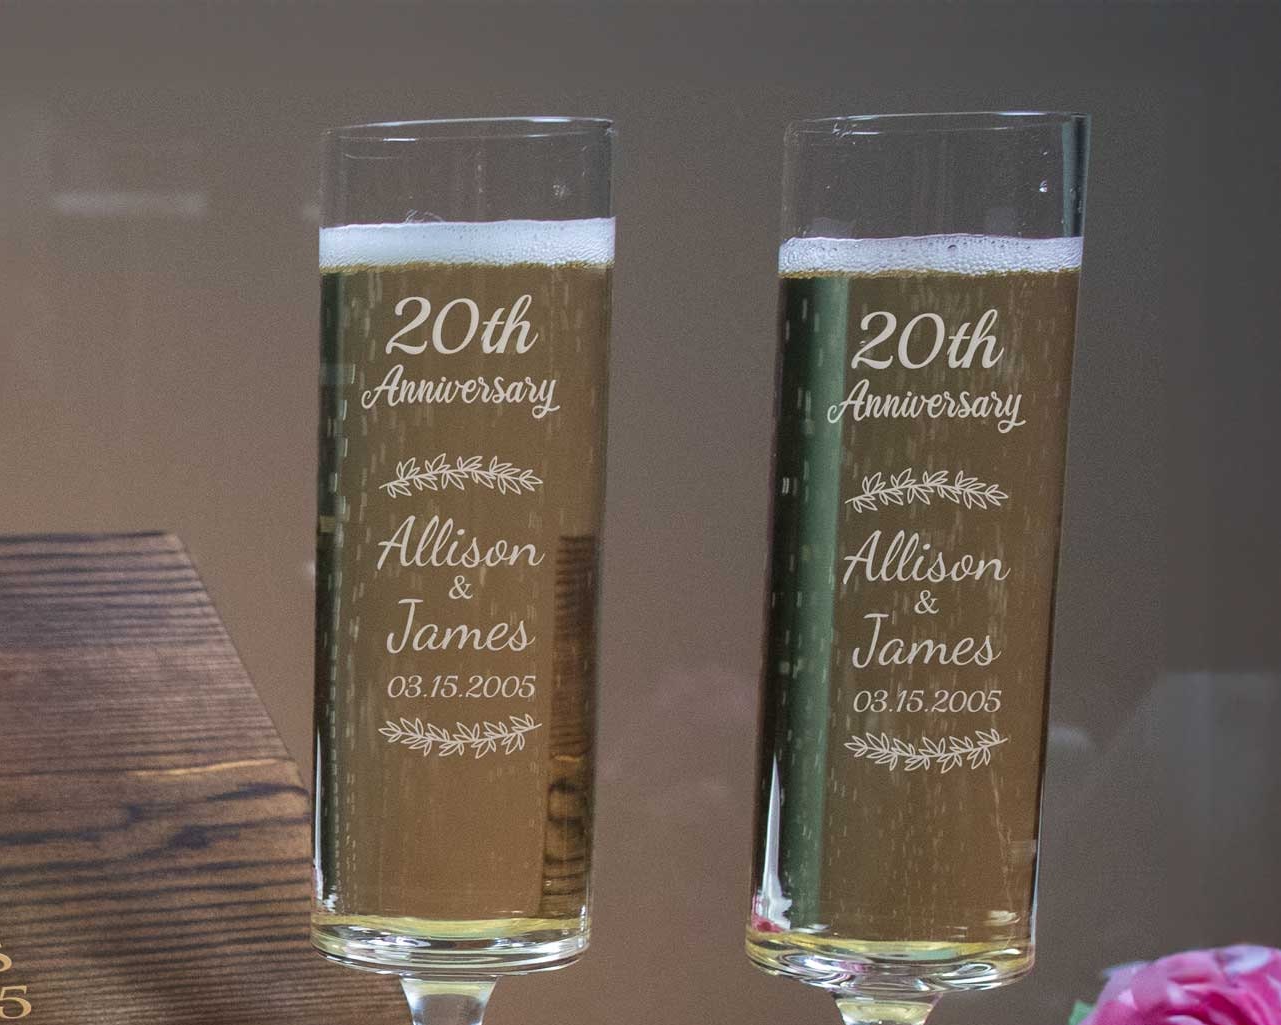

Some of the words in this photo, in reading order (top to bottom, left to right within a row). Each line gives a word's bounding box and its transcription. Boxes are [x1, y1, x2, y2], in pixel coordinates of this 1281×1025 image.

[384, 293, 539, 356] 20th
[850, 308, 1005, 371] 20th
[361, 363, 561, 420] Anniversary
[827, 378, 1027, 434] Anniversary
[376, 514, 545, 571] Allison
[842, 529, 1012, 586] Allison
[448, 575, 474, 600] &
[913, 589, 940, 615] &
[386, 598, 536, 655] James
[851, 613, 1002, 669] James
[386, 674, 536, 699] 03.15.2005
[852, 689, 1002, 714] 03.15.2005
